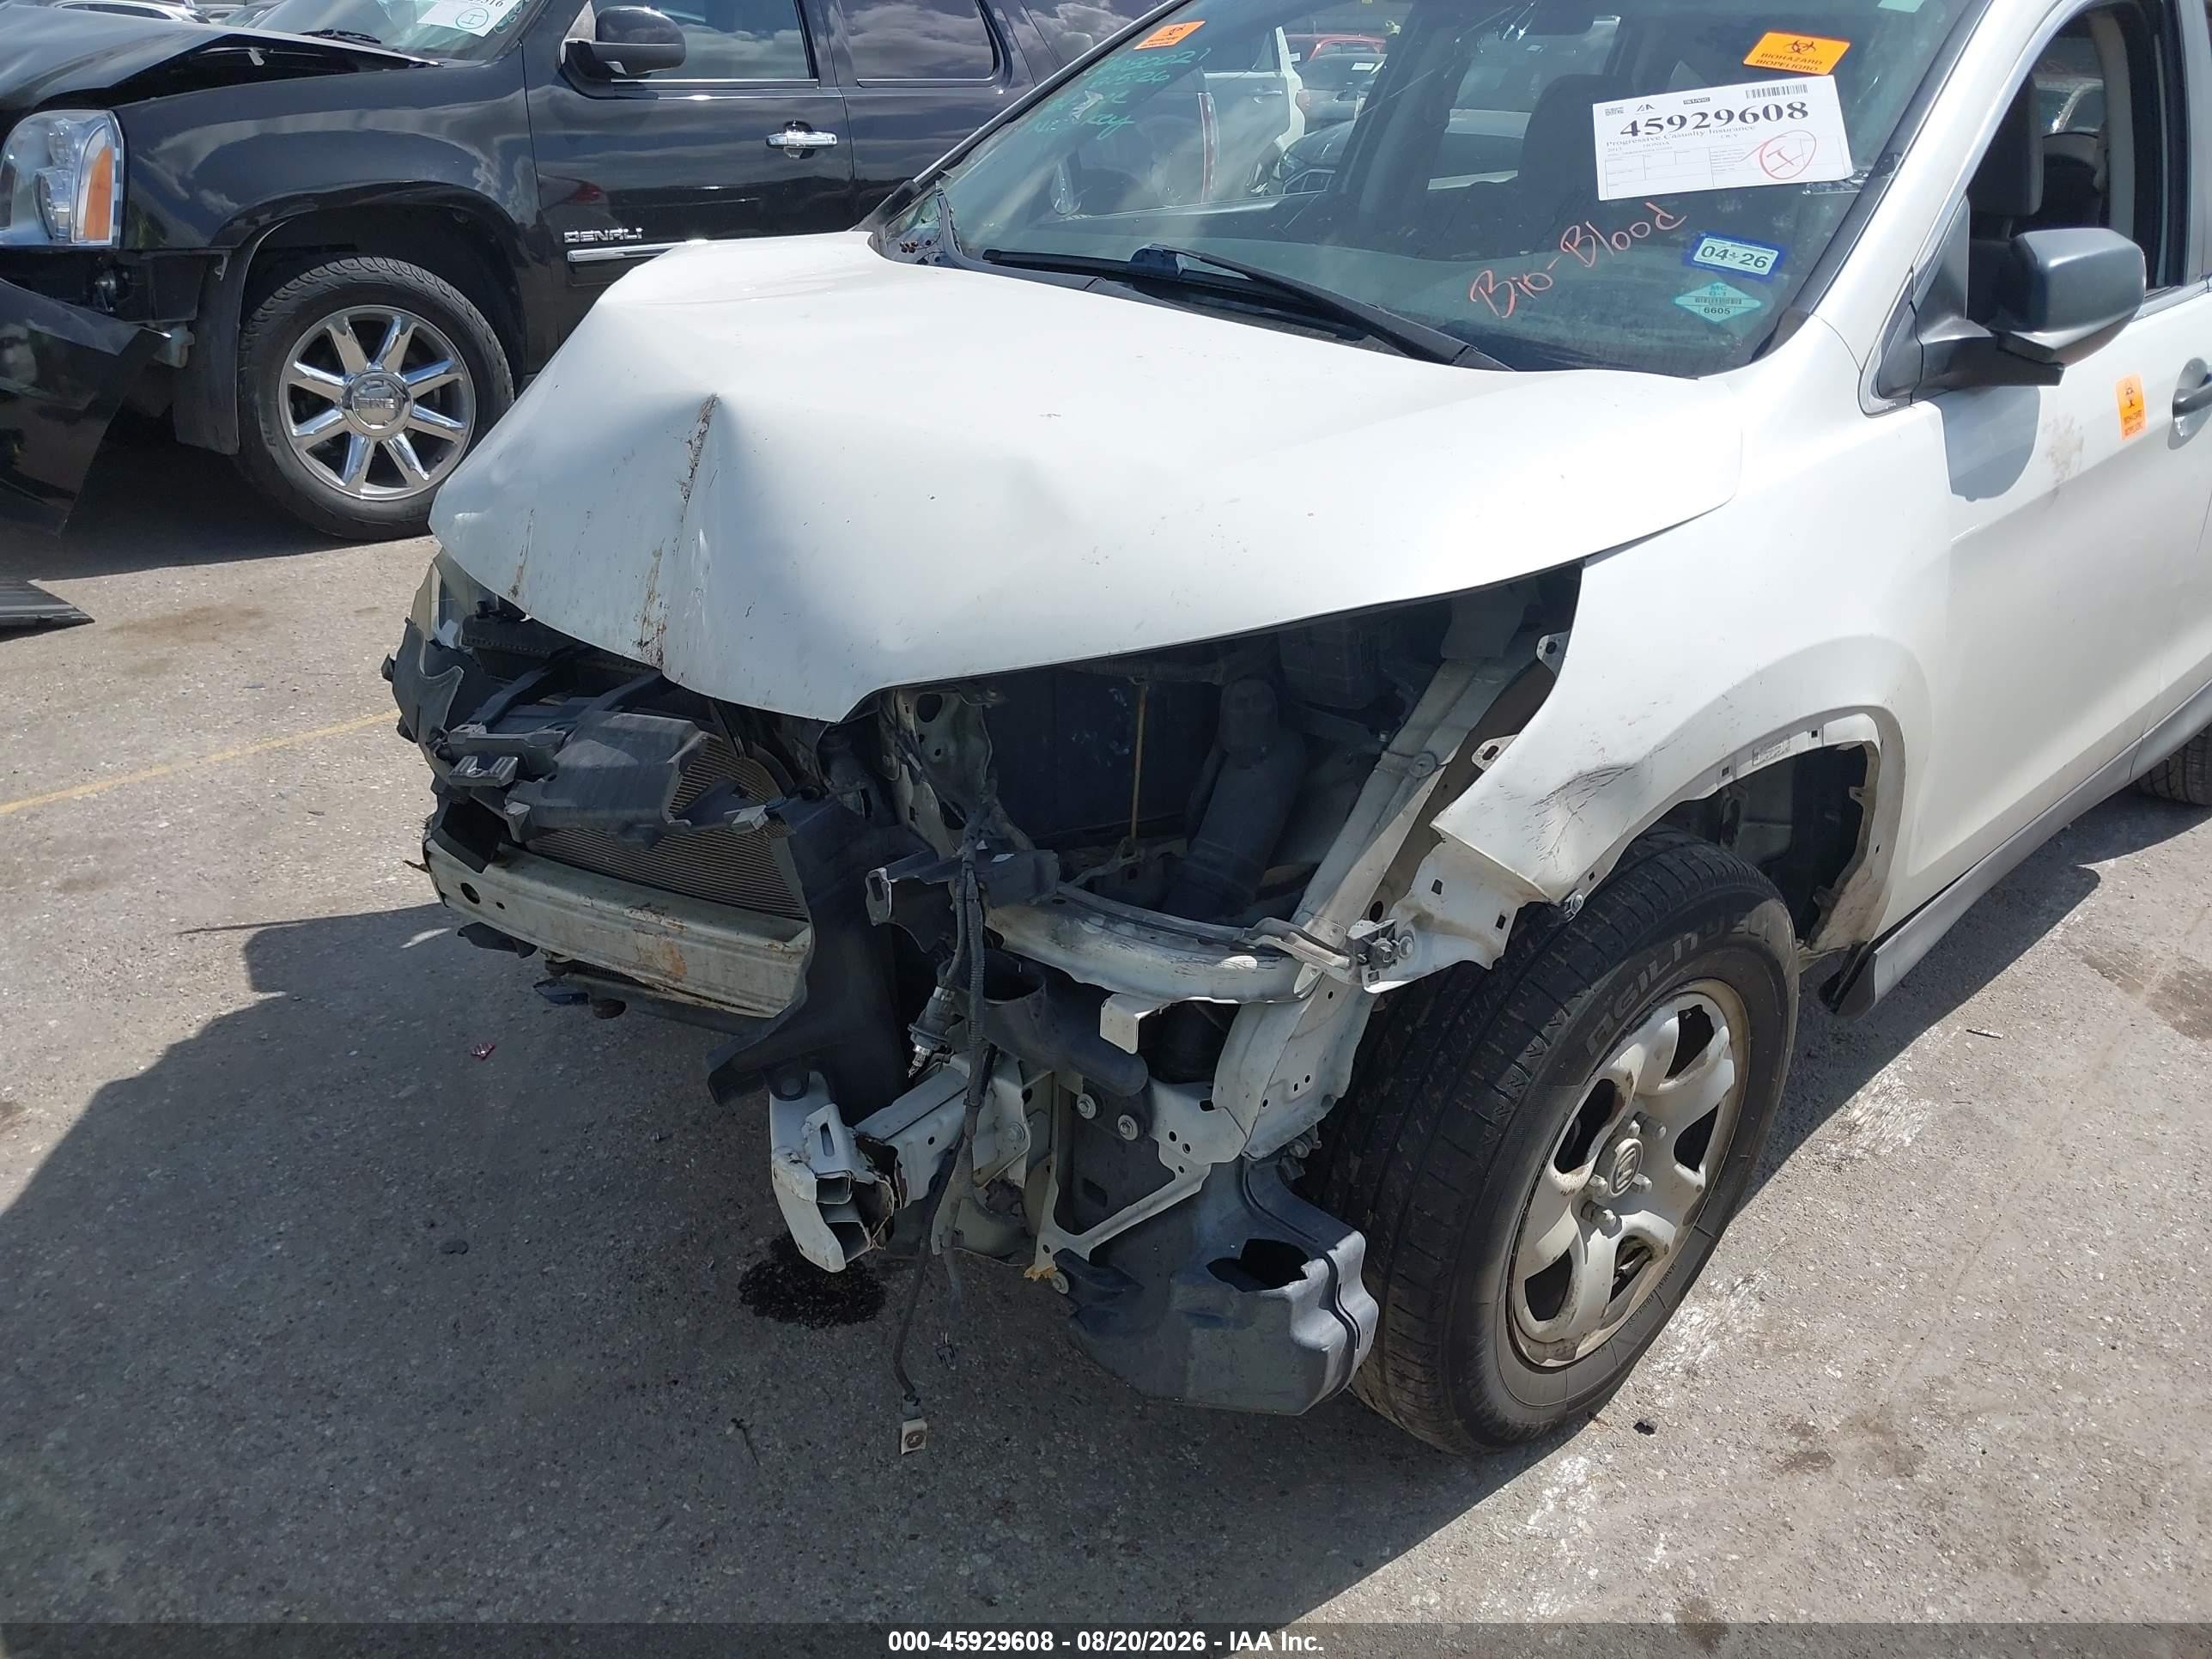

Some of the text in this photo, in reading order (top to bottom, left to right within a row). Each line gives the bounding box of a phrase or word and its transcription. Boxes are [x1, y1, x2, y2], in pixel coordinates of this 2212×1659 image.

[1755, 58, 1819, 71] BIOPELIGRO
[1760, 52, 1823, 65] BIOHAZARD
[1620, 100, 1809, 137] 45929608
[1606, 125, 1755, 148] Progressive Casualty Insurance
[563, 227, 643, 244] DENALI
[1469, 202, 1688, 320] Bio-Blood
[1700, 246, 1729, 261] 04
[1738, 252, 1770, 269] 26
[1704, 307, 1731, 315] 6605
